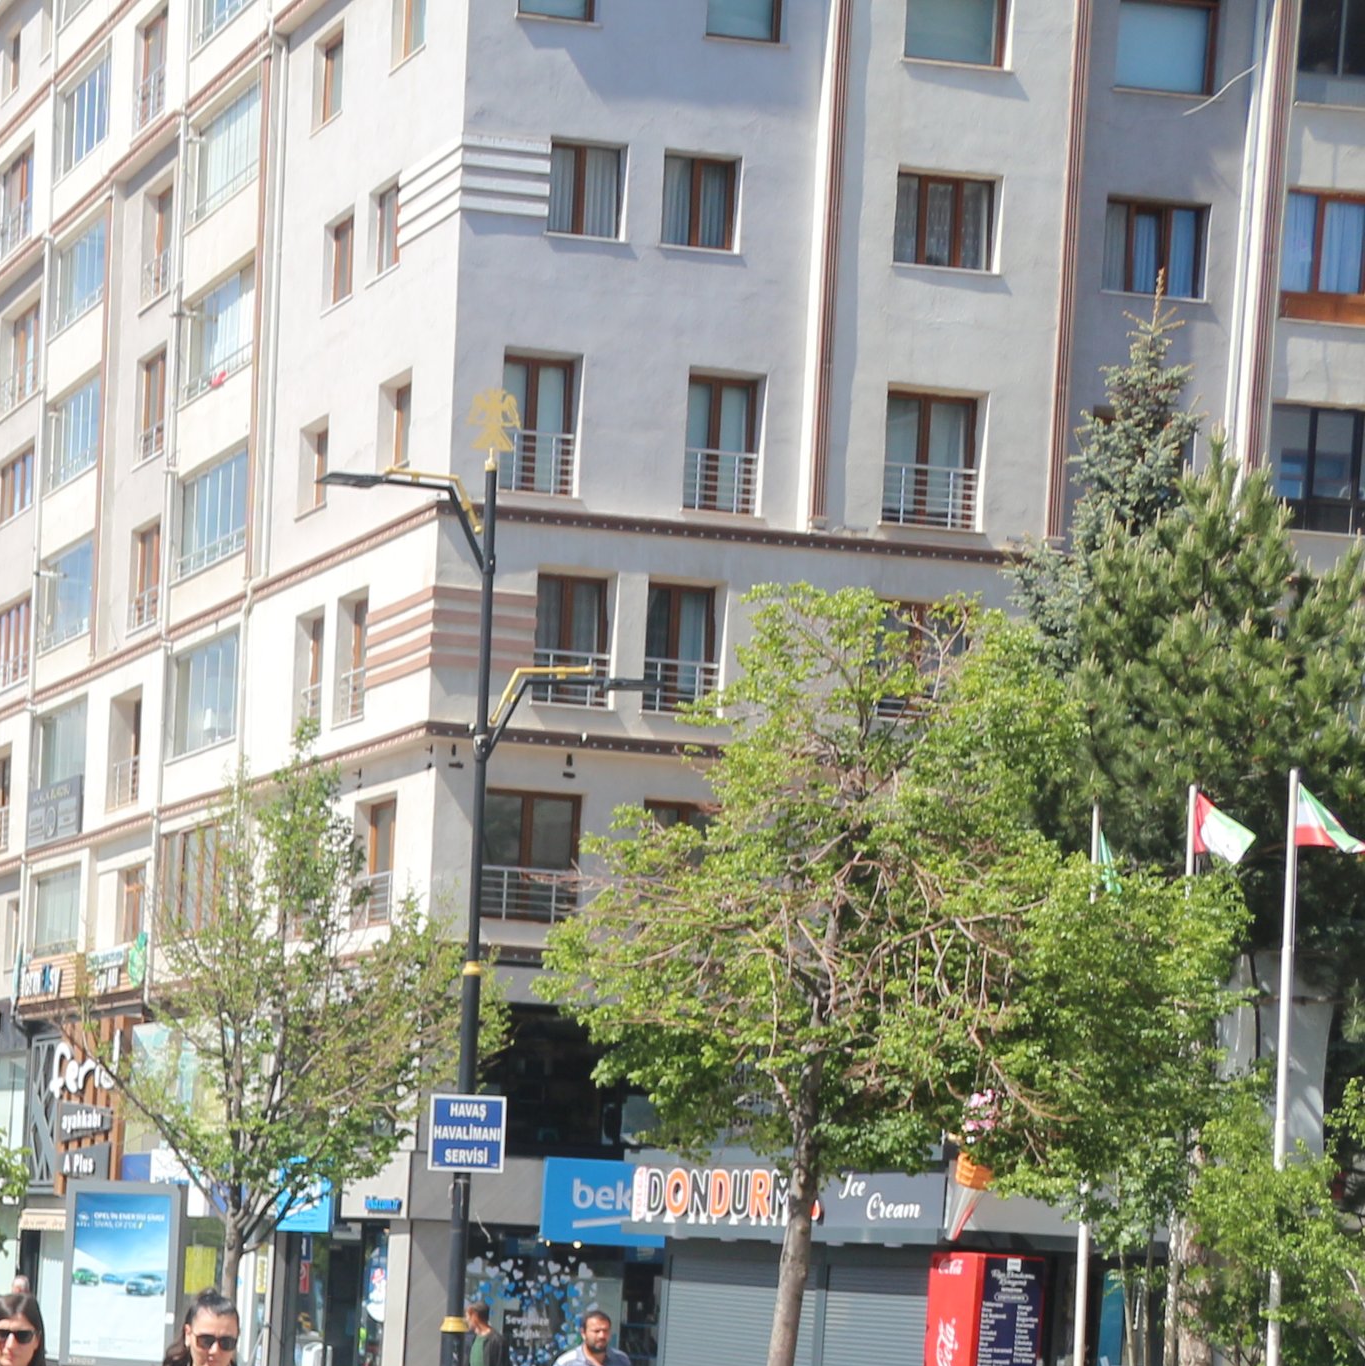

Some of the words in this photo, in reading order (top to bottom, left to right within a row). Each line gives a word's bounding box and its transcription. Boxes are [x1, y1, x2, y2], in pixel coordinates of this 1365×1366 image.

[449, 1102, 487, 1121] HAVAŞ
[433, 1123, 501, 1142] HAVALİMANI
[63, 1153, 71, 1173] A
[73, 1153, 94, 1175] Plus
[444, 1146, 488, 1165] SERVİSİ
[572, 1178, 632, 1210] bek
[647, 1167, 821, 1219] DONDURM
[838, 1173, 867, 1200] Ice
[866, 1192, 921, 1221] Cream
